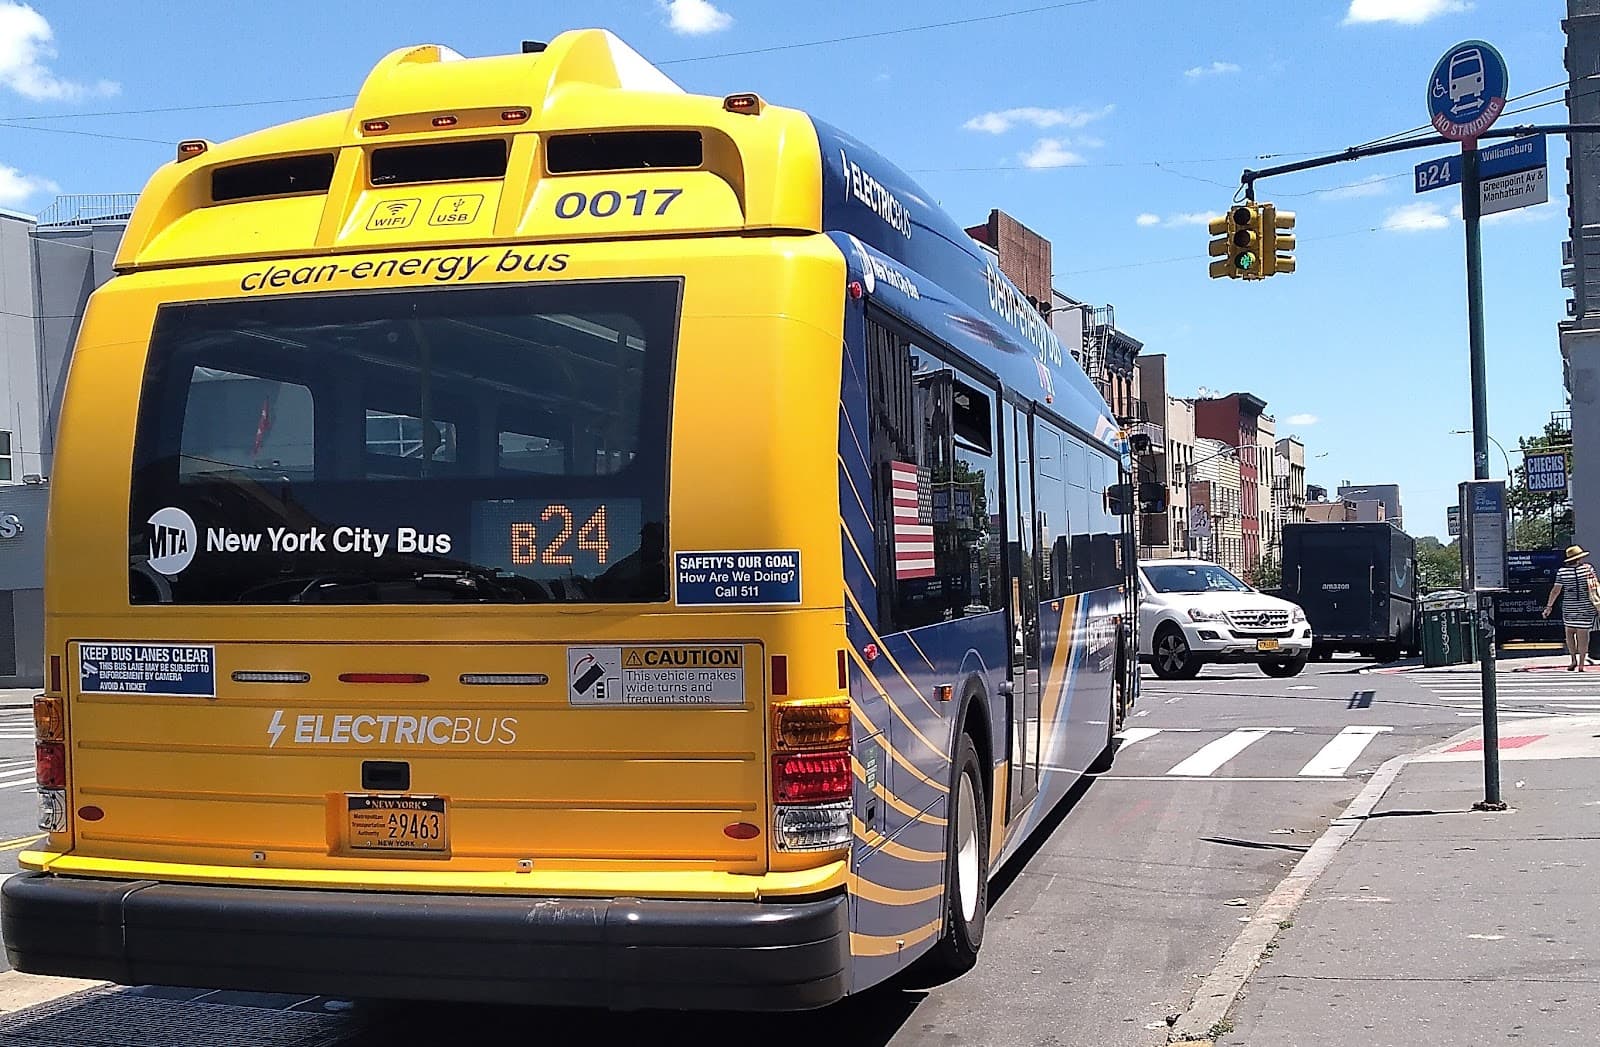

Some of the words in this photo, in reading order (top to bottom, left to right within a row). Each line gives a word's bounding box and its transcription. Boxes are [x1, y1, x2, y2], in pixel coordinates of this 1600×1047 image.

[1435, 115, 1449, 132] NO
[1451, 103, 1499, 136] STANDING
[1482, 142, 1533, 162] Williamsburg
[1418, 162, 1450, 188] B24
[1483, 174, 1525, 192] Greenpoint
[1525, 172, 1536, 183] Av
[1483, 187, 1524, 203] Manhattan
[1525, 183, 1536, 196] Av
[555, 188, 683, 220] 0017
[375, 215, 406, 228] WIFI
[436, 211, 469, 223] USB
[240, 252, 490, 292] clean-energy
[495, 248, 571, 273] bus
[1527, 455, 1564, 474] CHECKS
[1528, 472, 1566, 491] CASHED
[149, 524, 189, 561] MTA
[206, 527, 262, 552] New
[267, 527, 327, 552] York
[332, 526, 389, 558] City
[397, 527, 452, 553] Bus
[511, 504, 609, 565] B24
[680, 556, 734, 571] SAFETY'S
[738, 556, 761, 569] OUR
[765, 555, 796, 569] GOAL
[680, 572, 706, 583] How
[709, 571, 729, 583] Are
[732, 571, 751, 582] We
[754, 570, 795, 584] Doing?
[715, 586, 738, 598] Call
[740, 586, 759, 598] 511
[1321, 583, 1350, 591] amazon
[82, 647, 109, 661] KEEP
[111, 648, 132, 662] BUS
[135, 648, 170, 663] LANES
[172, 649, 208, 664] CLEAR
[644, 649, 739, 666] CAUTION
[99, 662, 113, 670] THIS
[114, 662, 127, 671] BUS
[127, 663, 144, 671] LANE
[145, 663, 159, 672] MAY
[160, 664, 169, 672] BE
[170, 664, 199, 673] SUBJECT
[200, 664, 209, 673] TO
[626, 670, 652, 681] This
[654, 670, 695, 681] vehicle
[698, 670, 736, 681] makes
[99, 672, 144, 680] ENFORCEMENT
[145, 672, 153, 681] BY
[155, 673, 182, 681] CAMERA
[100, 682, 118, 690] AVOID
[119, 682, 125, 691] A
[125, 682, 147, 691] TICKET
[626, 682, 654, 692] wide
[657, 682, 687, 692] turns
[690, 682, 713, 692] and
[294, 714, 518, 745] ELECTRICBUS
[371, 800, 394, 809] NEW
[396, 800, 421, 810] YORK
[399, 813, 439, 840] 9463
